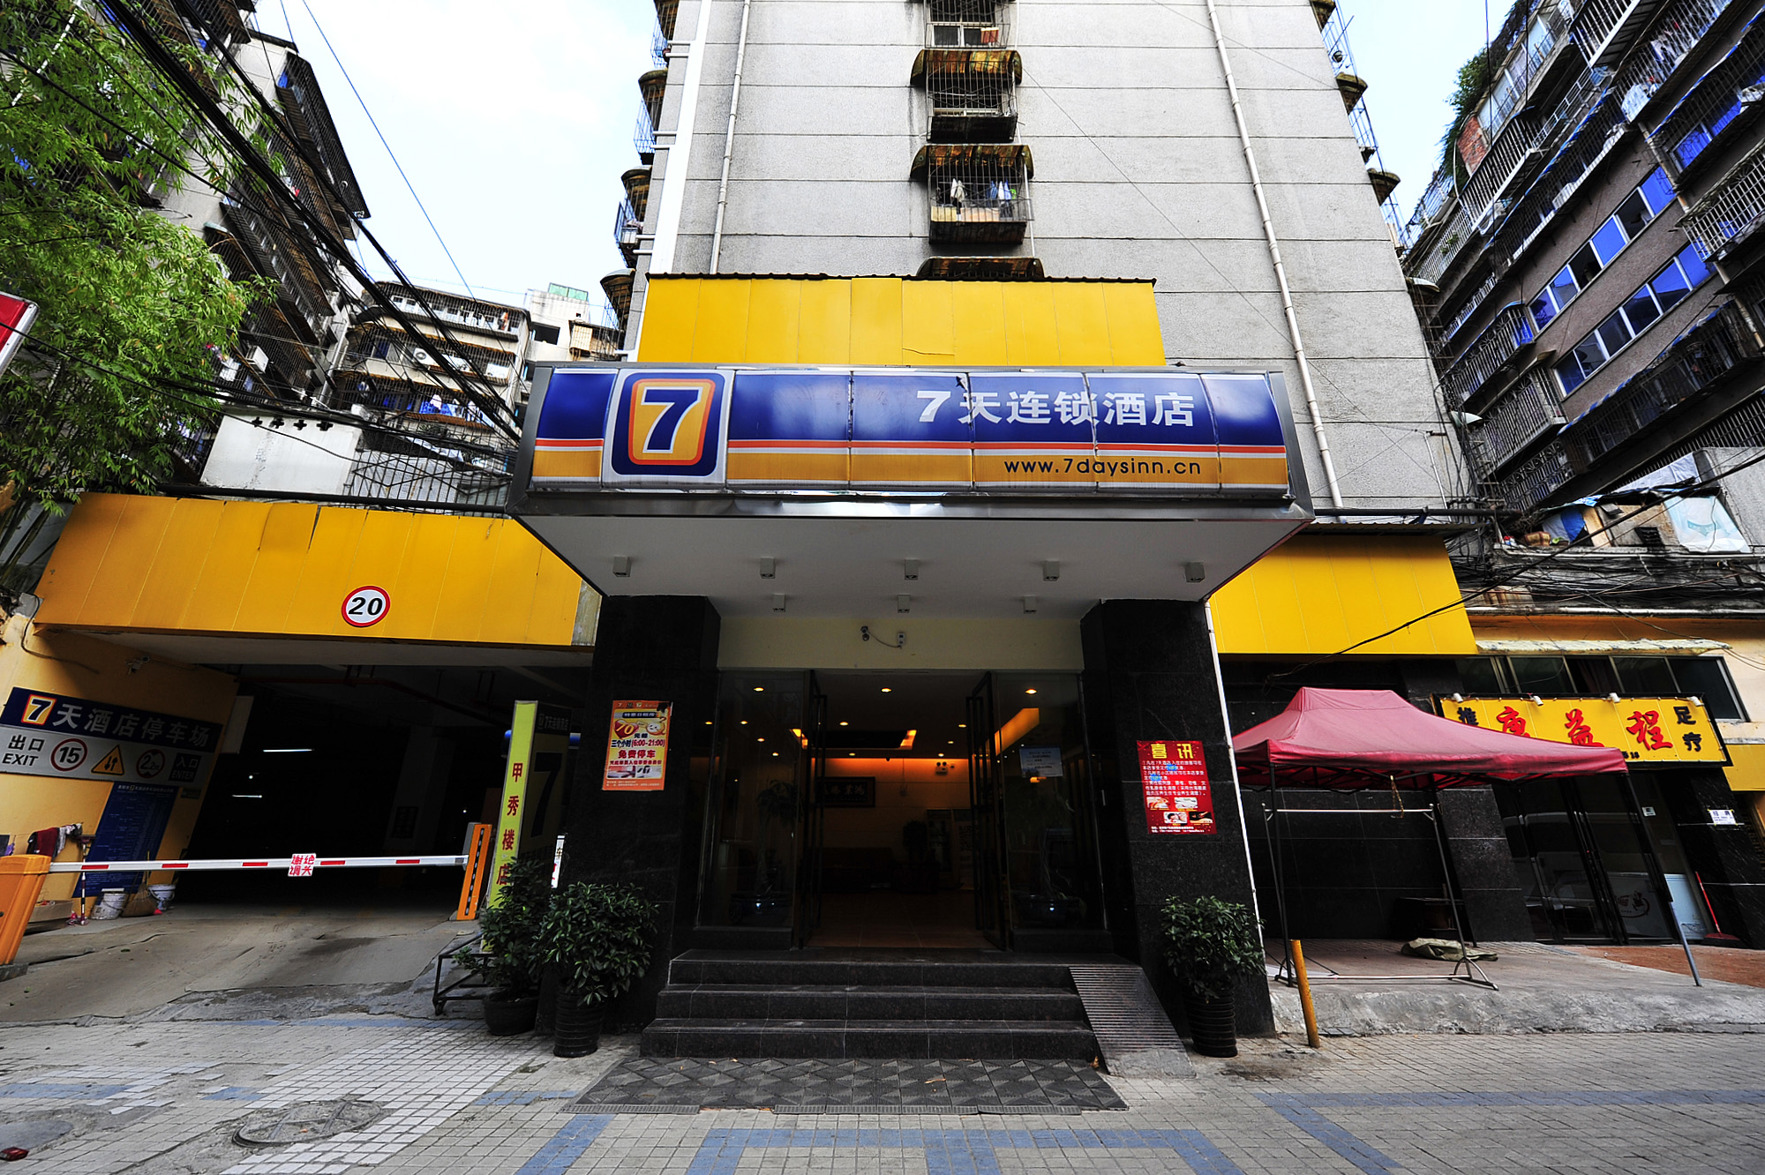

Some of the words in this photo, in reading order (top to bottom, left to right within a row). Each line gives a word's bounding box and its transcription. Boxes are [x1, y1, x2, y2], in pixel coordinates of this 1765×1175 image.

[916, 390, 1195, 427] 7天连锁酒店
[641, 386, 703, 454] 7
[1004, 458, 1201, 477] www.7daysinn.cn
[348, 596, 383, 616] 20
[1673, 705, 1702, 752] 足疗
[8, 734, 45, 752] 出口
[1150, 743, 1194, 759] 喜讯
[2, 753, 39, 767] EXIT
[58, 746, 82, 764] 15
[176, 755, 199, 769] 入口
[618, 749, 656, 759] 免费停车
